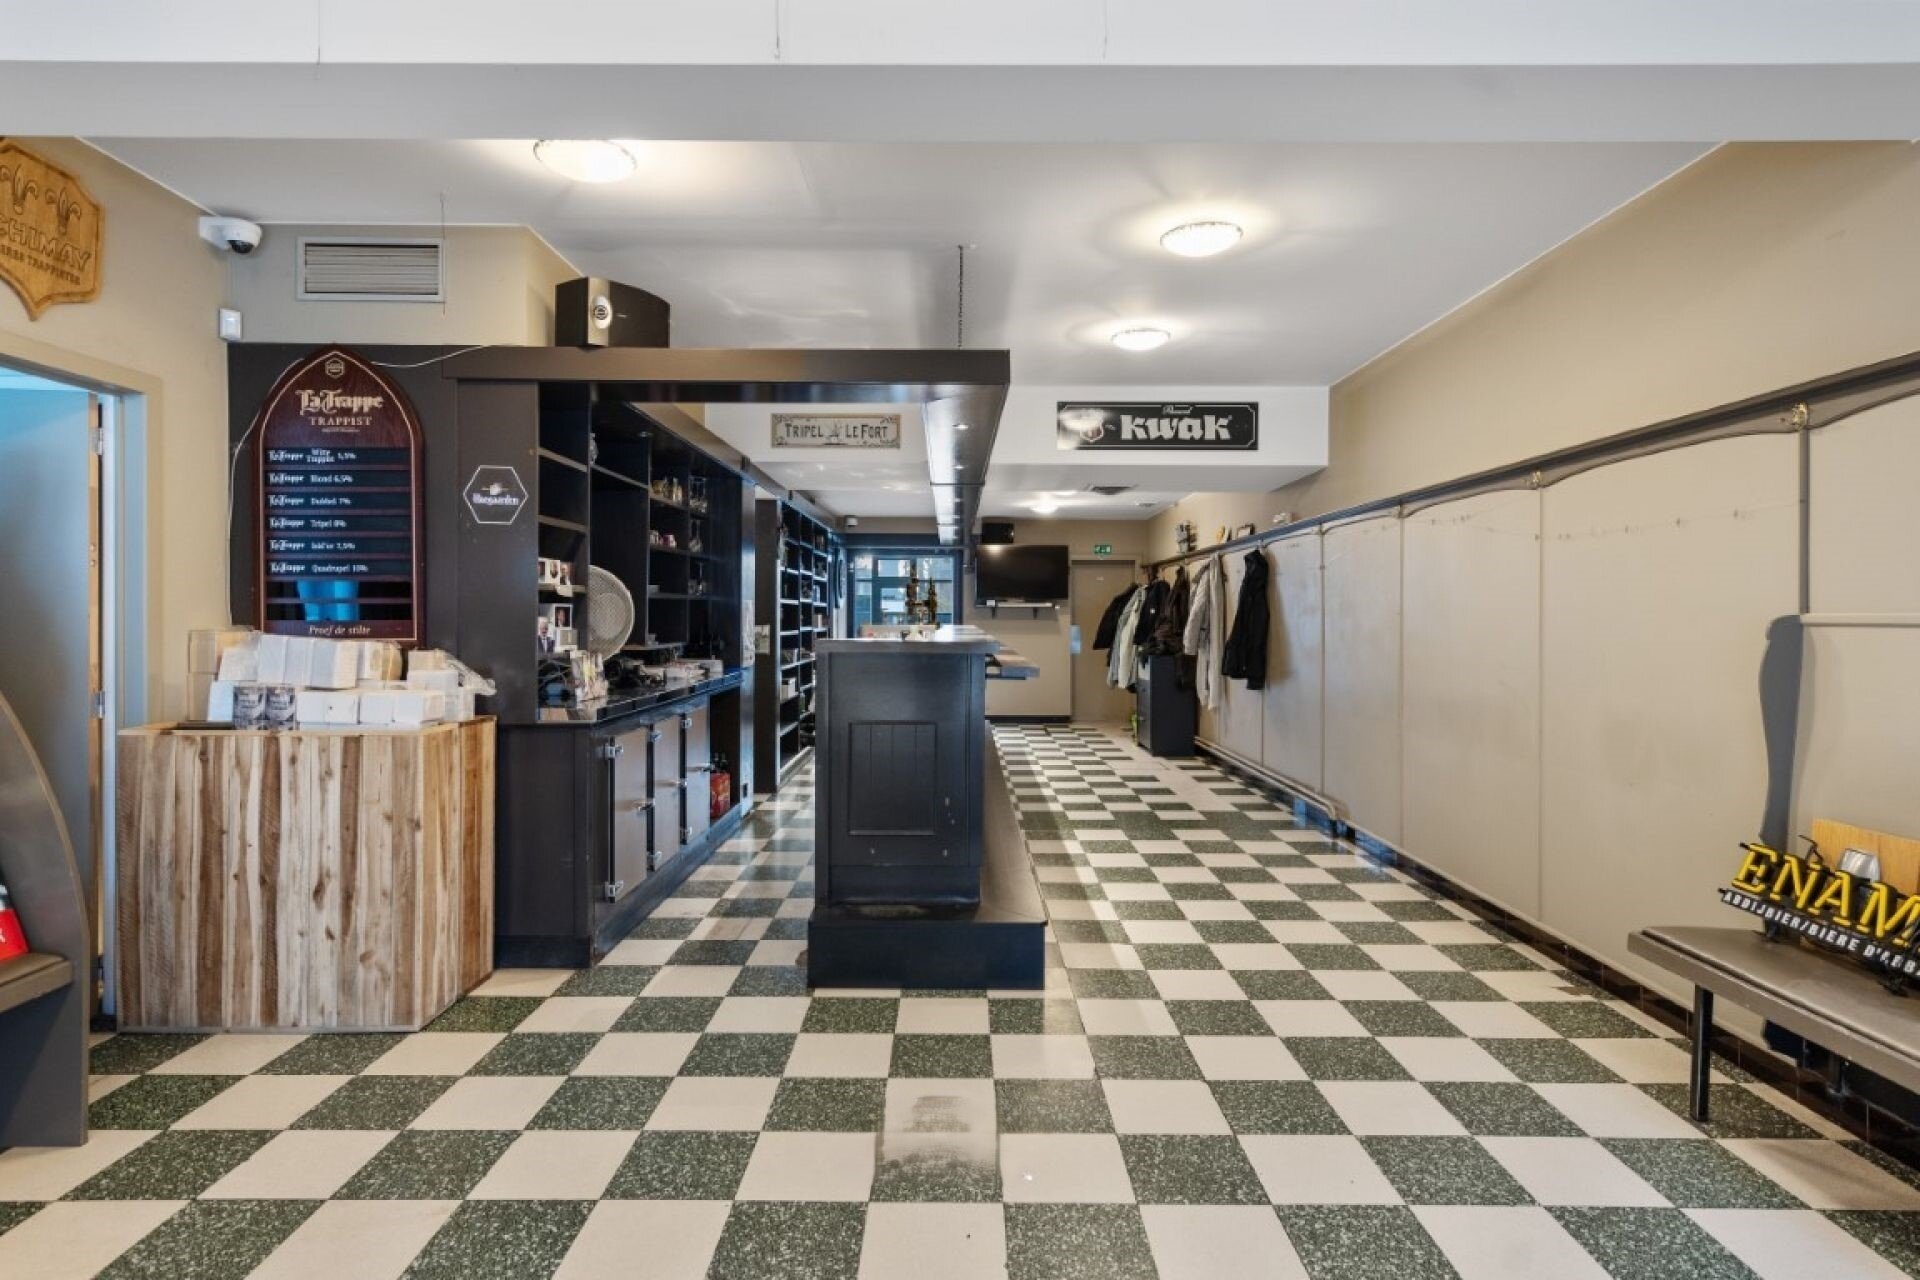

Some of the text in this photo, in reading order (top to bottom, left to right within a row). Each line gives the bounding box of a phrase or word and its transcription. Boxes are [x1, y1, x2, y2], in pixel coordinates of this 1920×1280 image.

[309, 416, 373, 426] TRAPPIST
[784, 423, 824, 438] TRIPEL
[334, 625, 346, 635] de
[1731, 842, 1920, 947] ENAM
